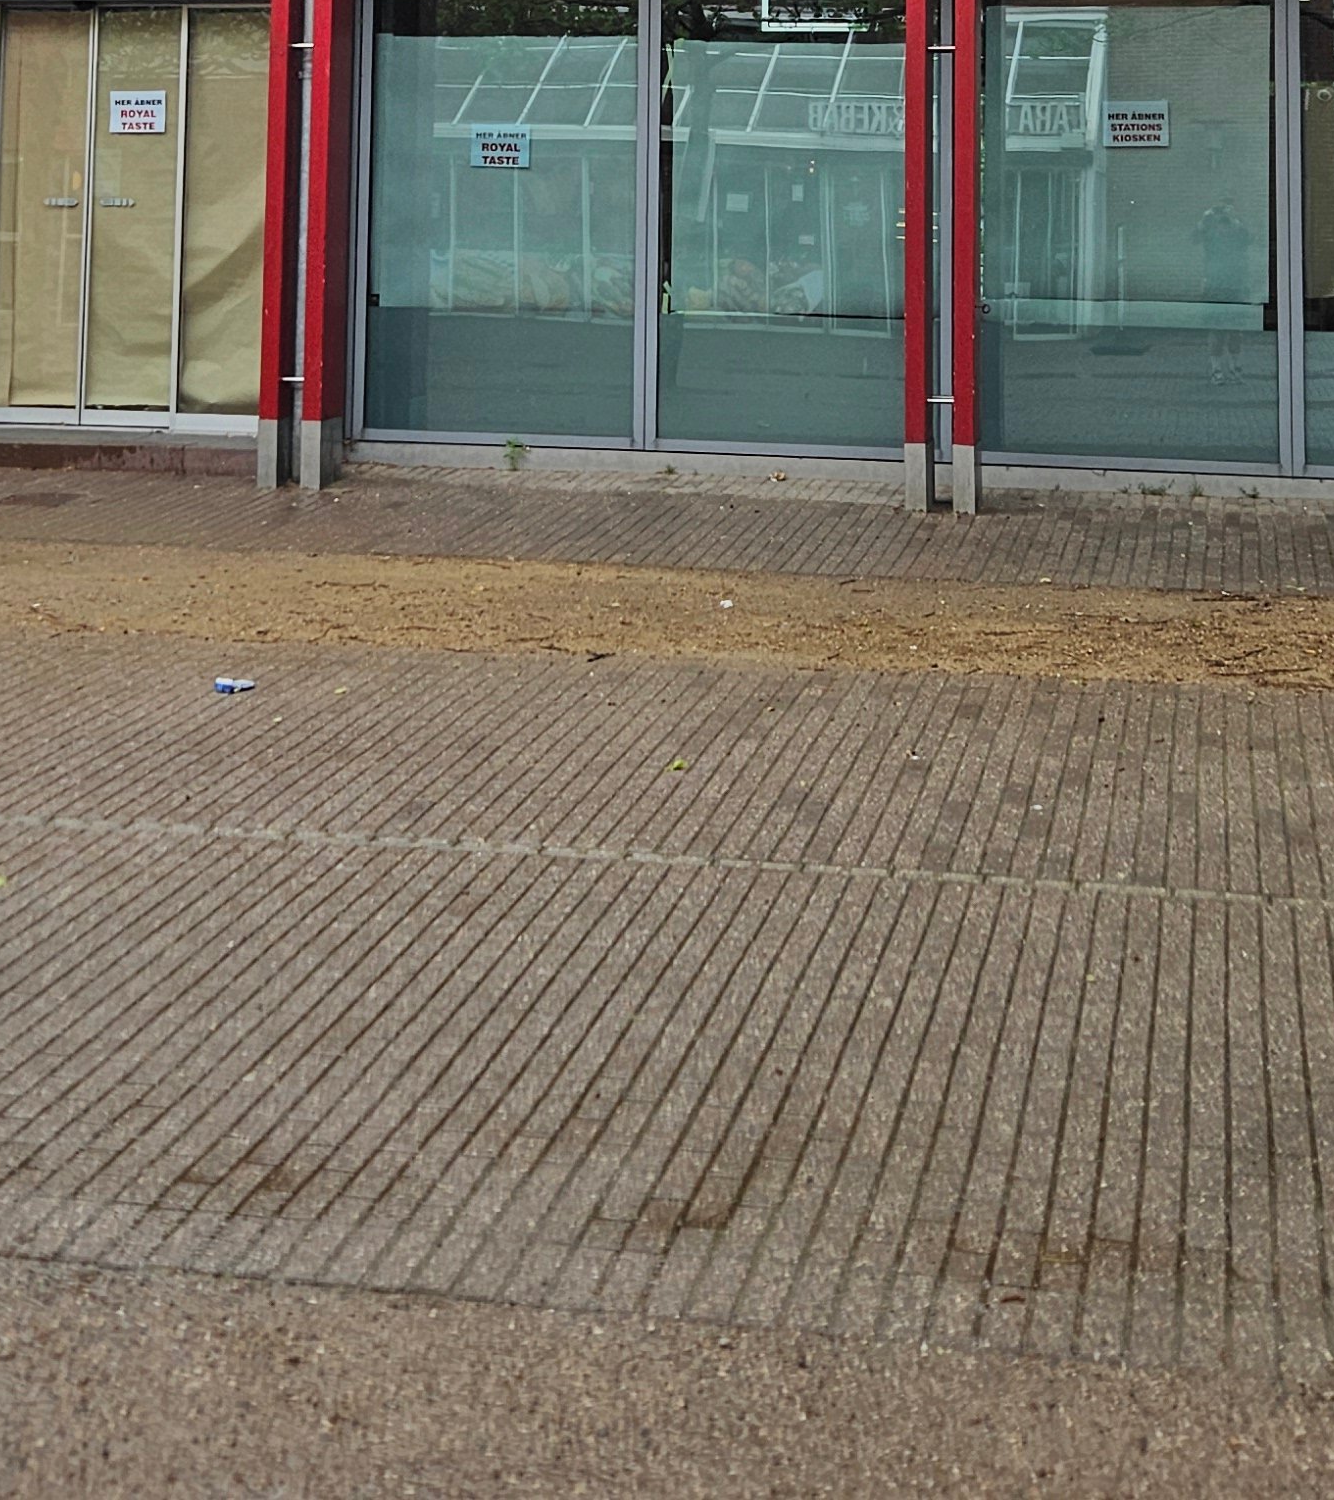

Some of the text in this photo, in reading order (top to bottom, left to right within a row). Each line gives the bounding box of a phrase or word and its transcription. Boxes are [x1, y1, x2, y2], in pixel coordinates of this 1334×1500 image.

[120, 109, 156, 118] ROYAL
[122, 122, 155, 130] TASTE
[1110, 123, 1162, 131] STATIONS
[1113, 134, 1160, 142] KIOSKEN
[481, 143, 520, 152] ROYAL
[482, 156, 519, 165] TASTE
